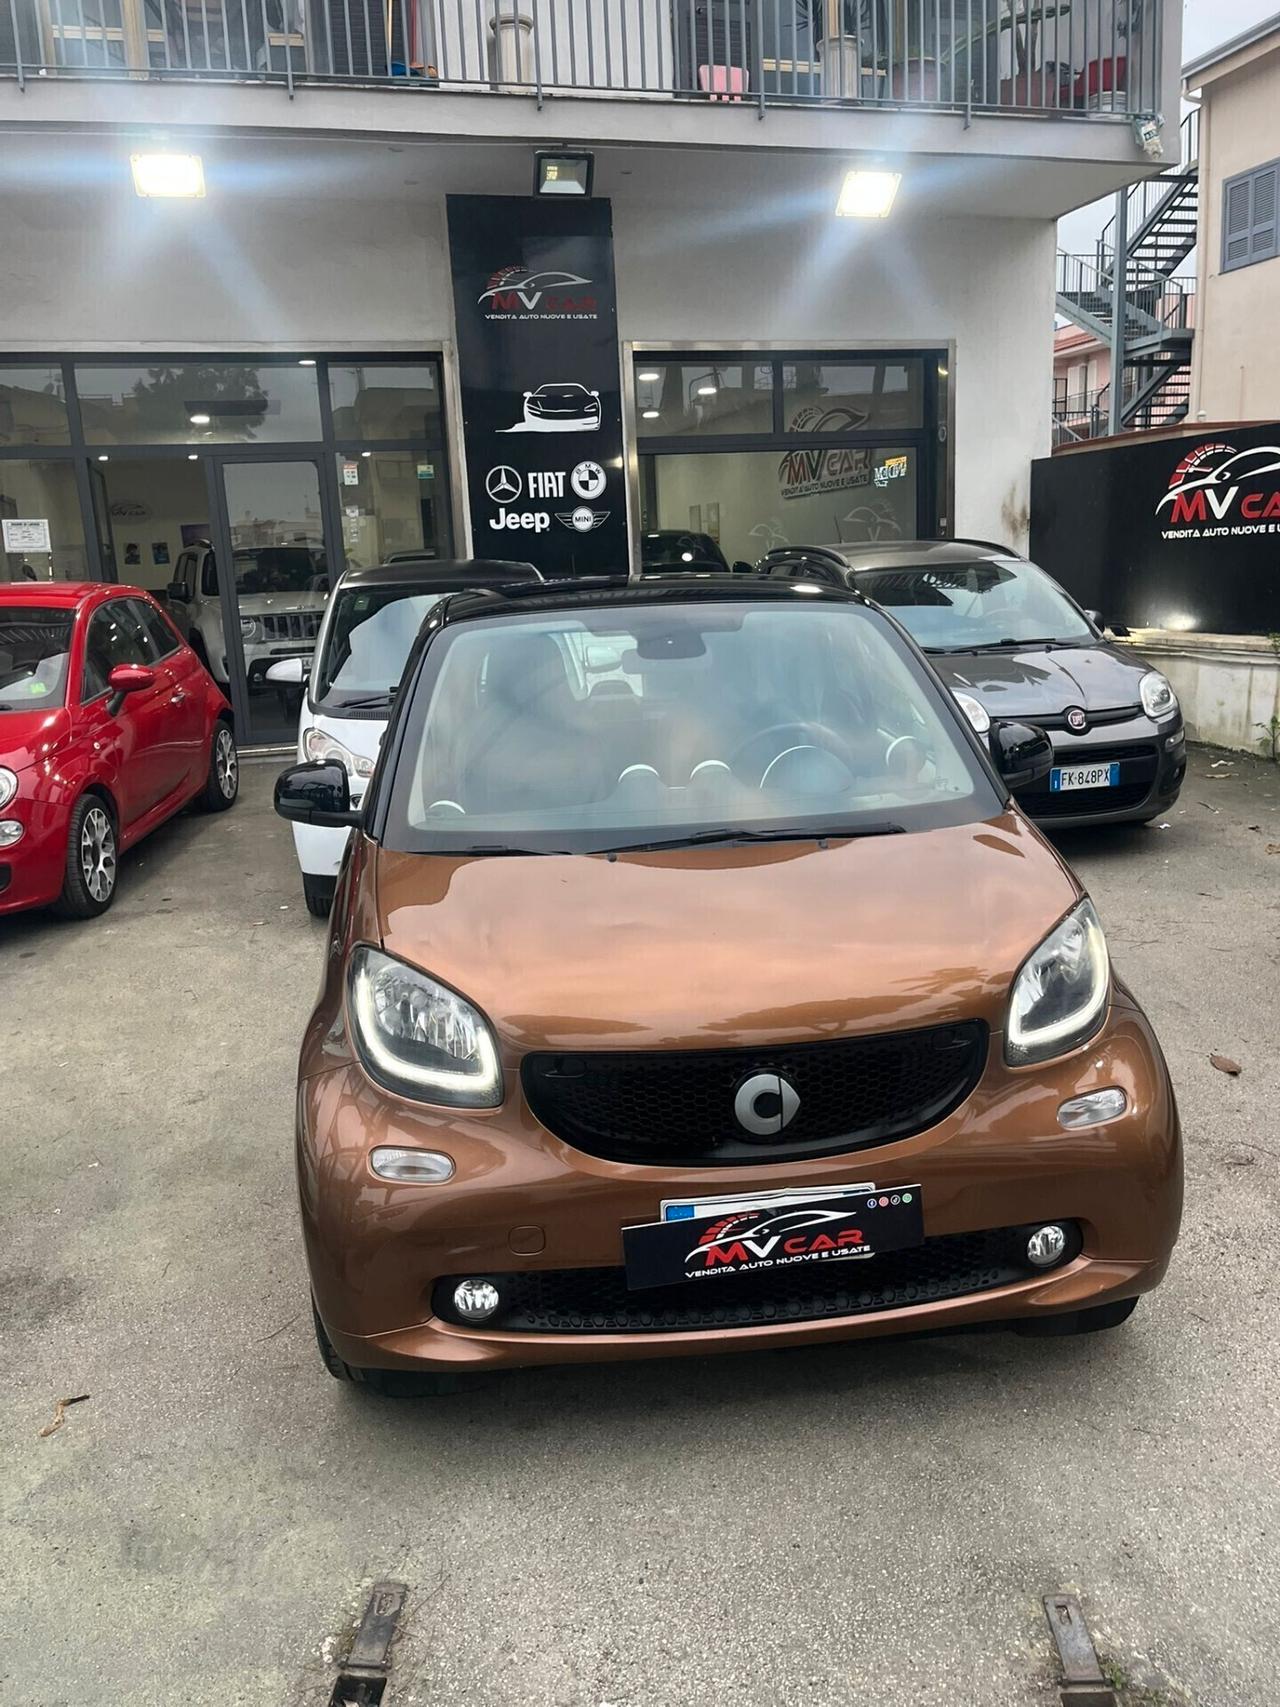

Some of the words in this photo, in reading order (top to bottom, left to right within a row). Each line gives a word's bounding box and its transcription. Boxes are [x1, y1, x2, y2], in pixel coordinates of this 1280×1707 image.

[491, 290, 542, 310] MV
[528, 472, 566, 498] FIAT
[1171, 486, 1239, 523] MV
[489, 507, 550, 533] Jeep
[1162, 529, 1201, 539] VENDITA
[1202, 526, 1229, 537] AUTO
[1231, 523, 1266, 535] NUOVE
[1268, 524, 1275, 533] E
[705, 1235, 782, 1267] MV
[783, 1229, 864, 1254] CAR
[685, 1265, 737, 1279] VENDITA
[739, 1259, 774, 1271] AUTO
[776, 1252, 820, 1266] NUOVE
[821, 1250, 829, 1258] E
[831, 1244, 871, 1257] USATE
